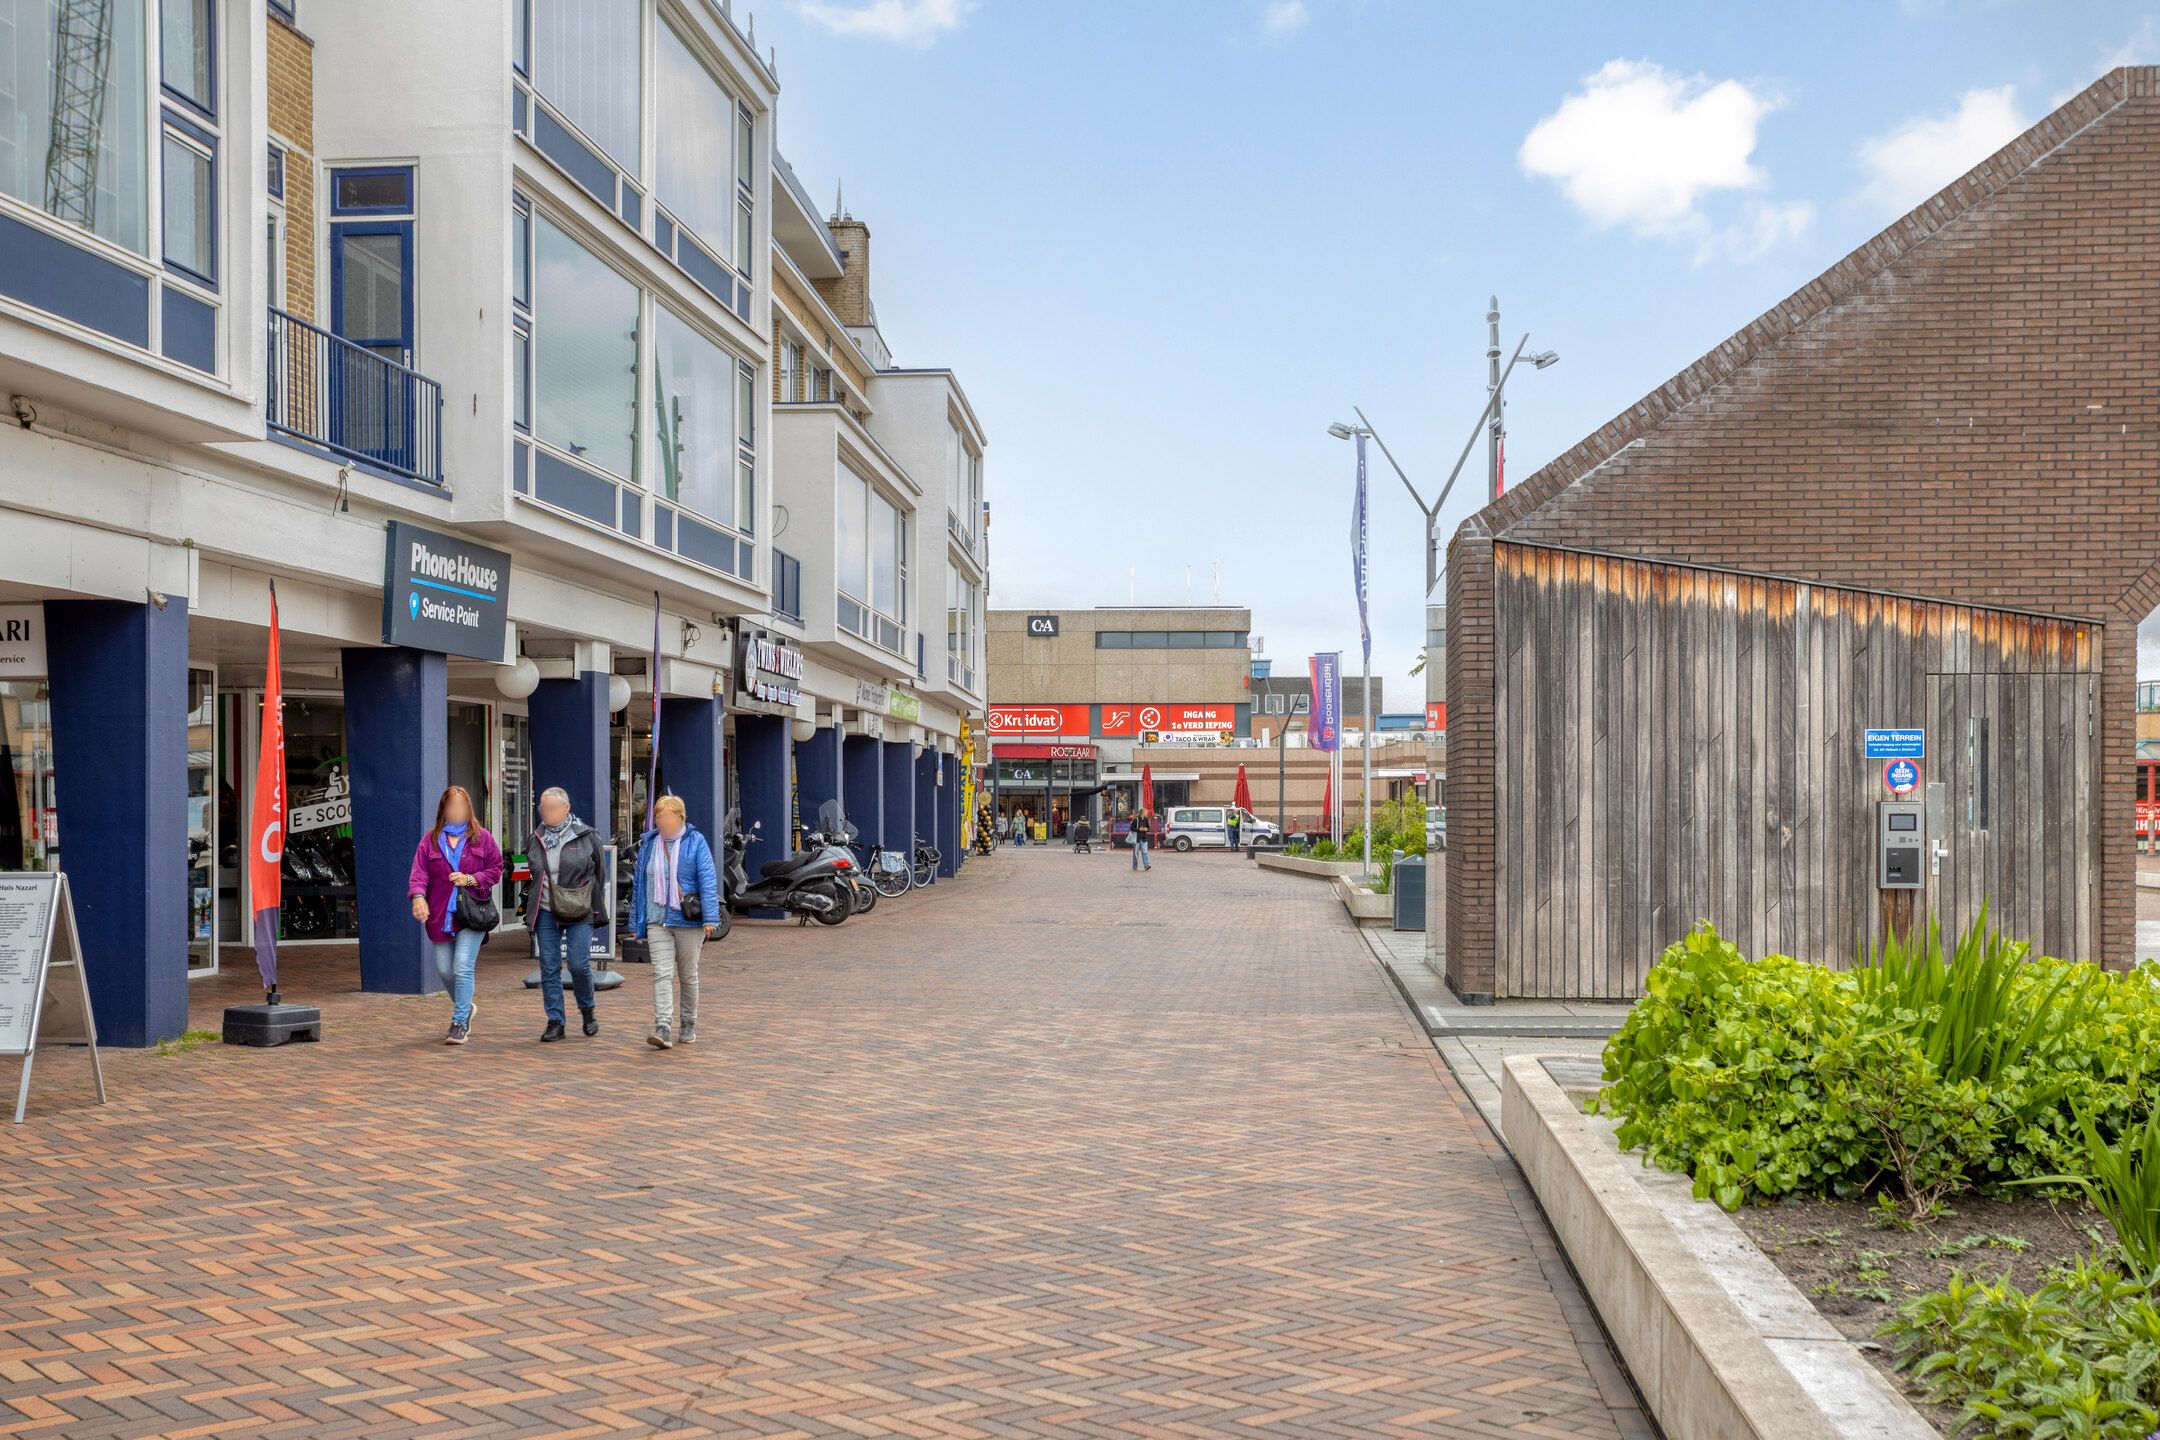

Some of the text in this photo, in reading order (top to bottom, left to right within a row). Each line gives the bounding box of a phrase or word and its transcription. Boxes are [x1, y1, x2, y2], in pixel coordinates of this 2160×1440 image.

[411, 542, 498, 592] Phone House
[422, 597, 480, 628] Service Point
[1031, 619, 1055, 632] C&A
[1004, 714, 1056, 727] Kruidvat
[293, 812, 303, 828] E
